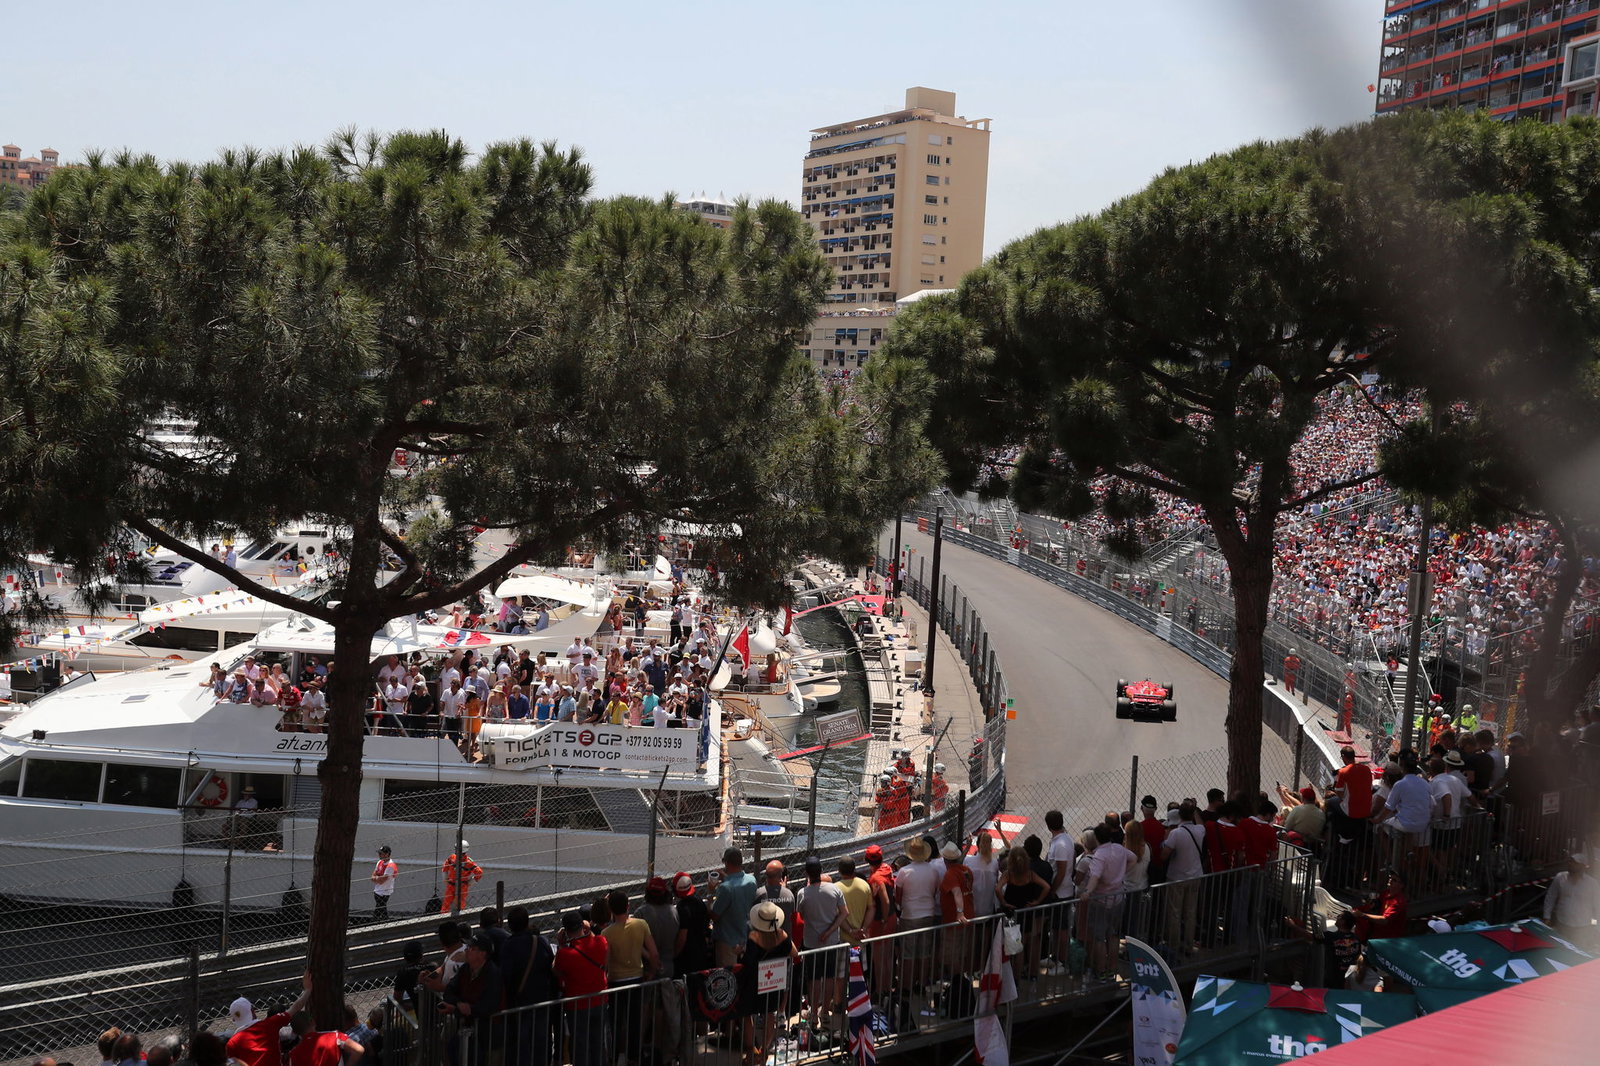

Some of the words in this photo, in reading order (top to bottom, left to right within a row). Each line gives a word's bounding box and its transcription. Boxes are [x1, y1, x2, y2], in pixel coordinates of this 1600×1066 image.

[823, 725, 843, 735] GRAND
[844, 722, 857, 731] PRIX
[626, 735, 642, 747] +377
[643, 736, 651, 747] 92
[653, 737, 662, 748] 05
[663, 737, 672, 749] 59
[673, 738, 682, 749] 59
[562, 749, 568, 757] &
[573, 749, 621, 760] MOTOGP
[1439, 948, 1482, 978] thg
